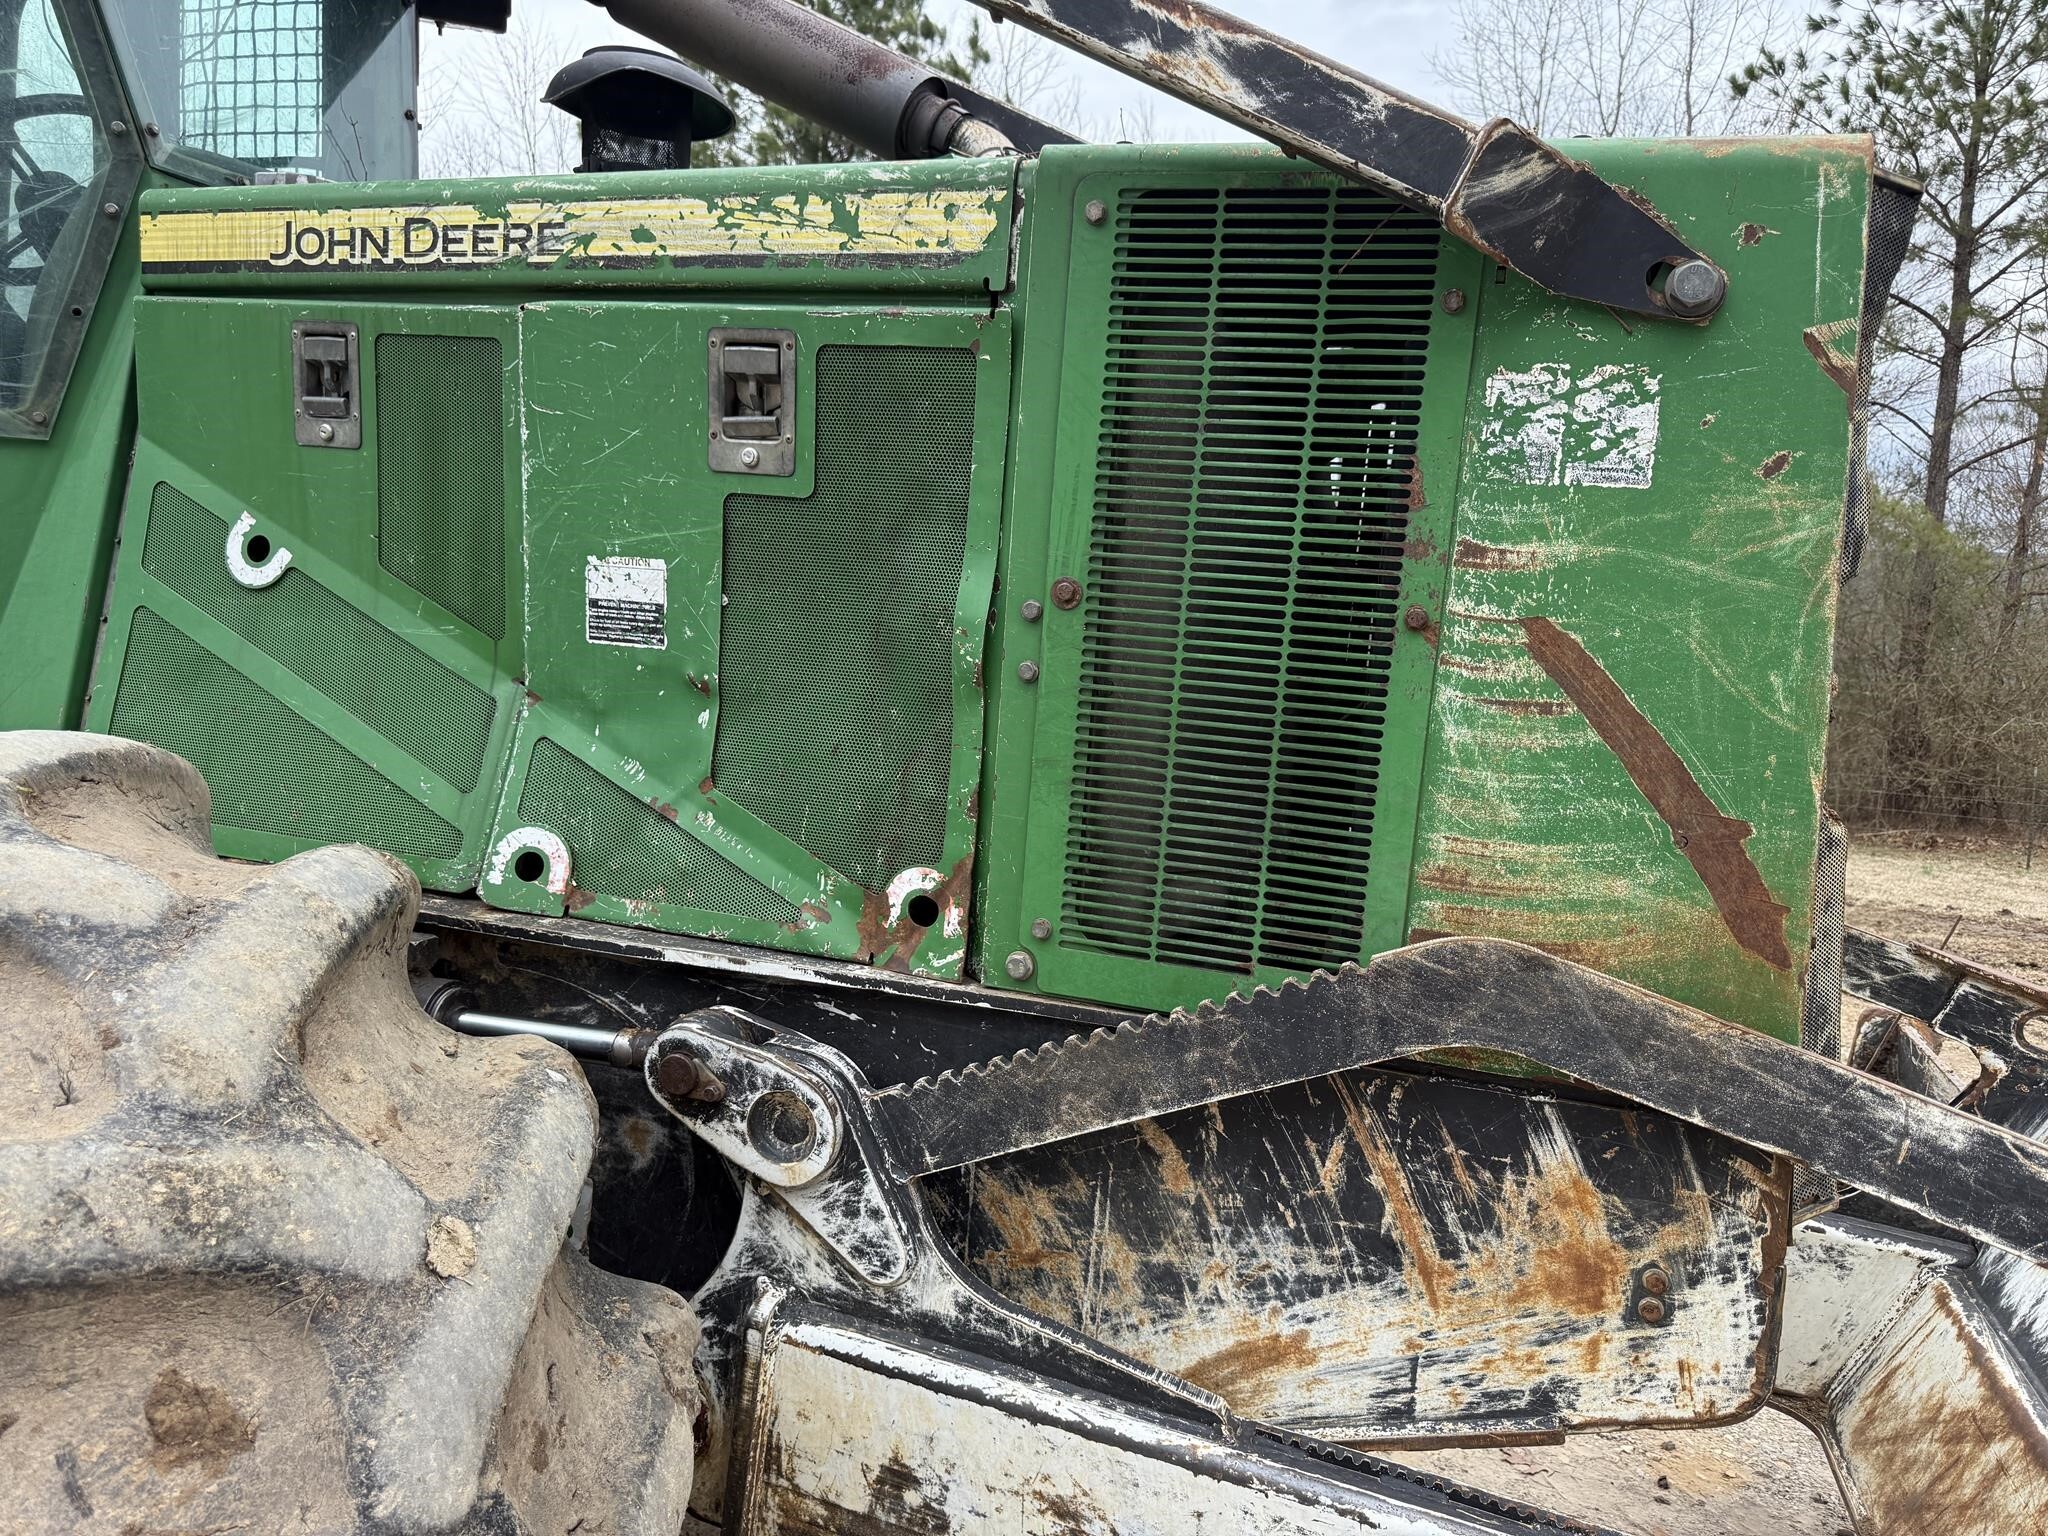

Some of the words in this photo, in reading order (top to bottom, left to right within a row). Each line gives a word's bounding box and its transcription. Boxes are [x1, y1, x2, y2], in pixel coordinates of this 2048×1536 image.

[270, 220, 390, 261] JOHN
[404, 217, 567, 259] DEERE
[612, 557, 651, 567] CAUTION
